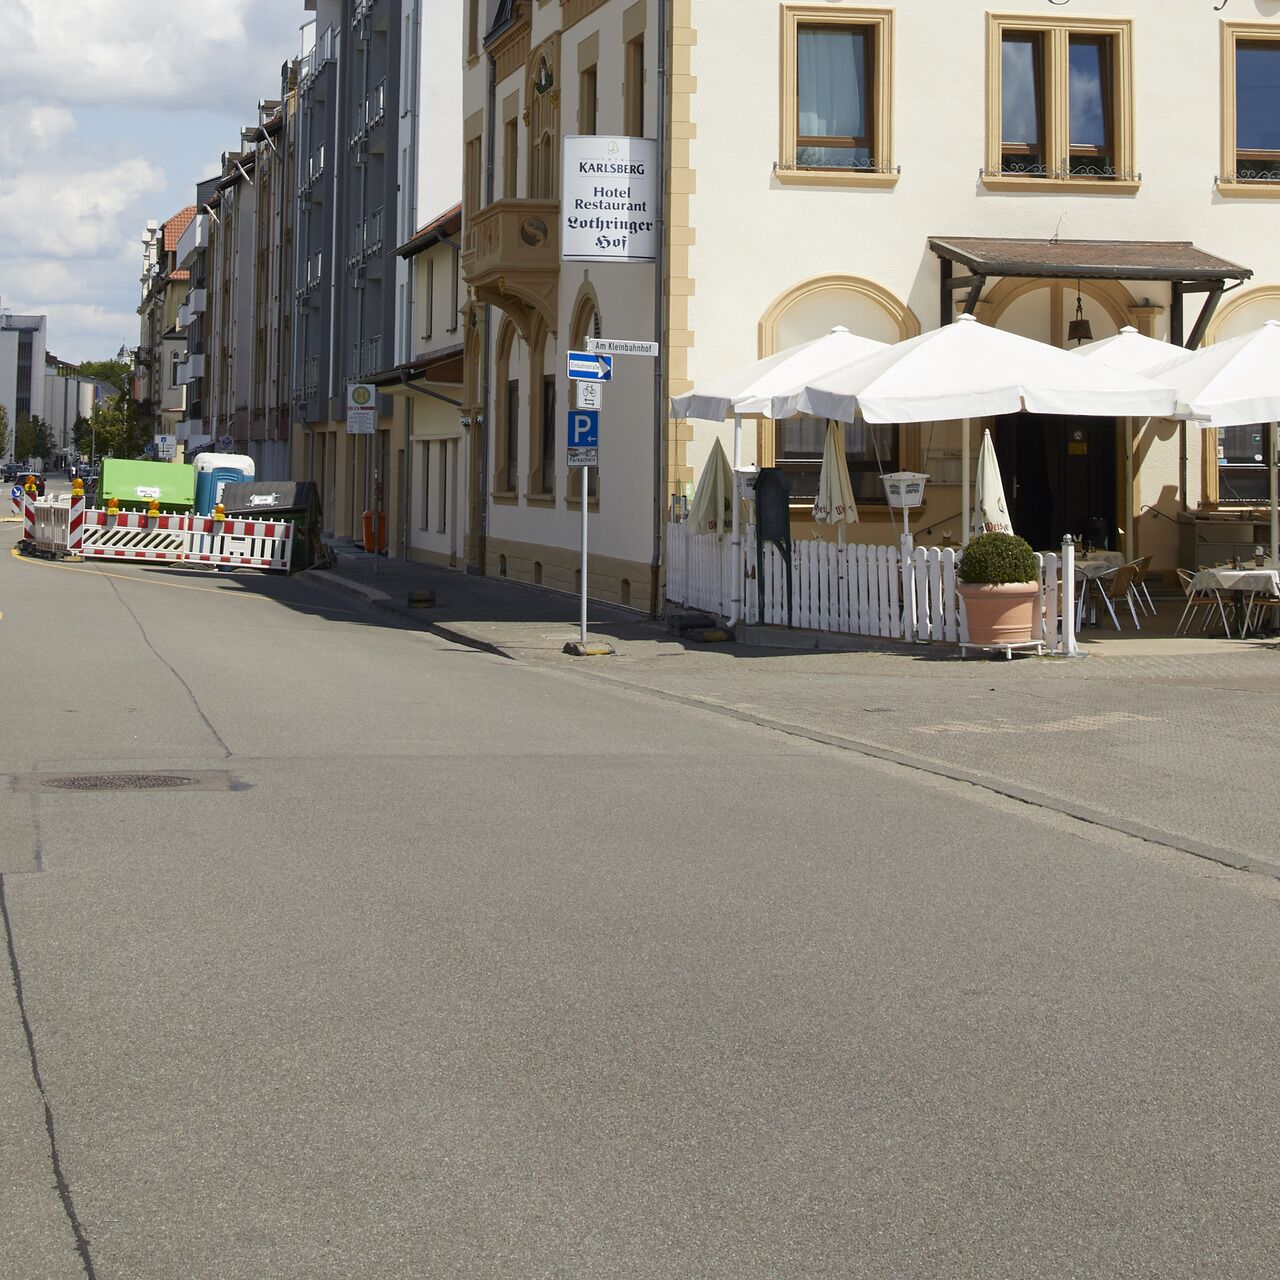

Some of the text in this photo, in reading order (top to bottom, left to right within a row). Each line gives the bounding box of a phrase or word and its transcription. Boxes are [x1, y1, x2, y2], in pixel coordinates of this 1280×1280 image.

[579, 161, 645, 175] KARLSBERG
[593, 186, 631, 198] Hotel
[575, 198, 647, 212] Restaurant
[567, 215, 653, 235] Lothringer
[595, 235, 627, 252] Hof
[595, 341, 652, 353] Am Kleinbahnhof
[574, 415, 592, 443] P
